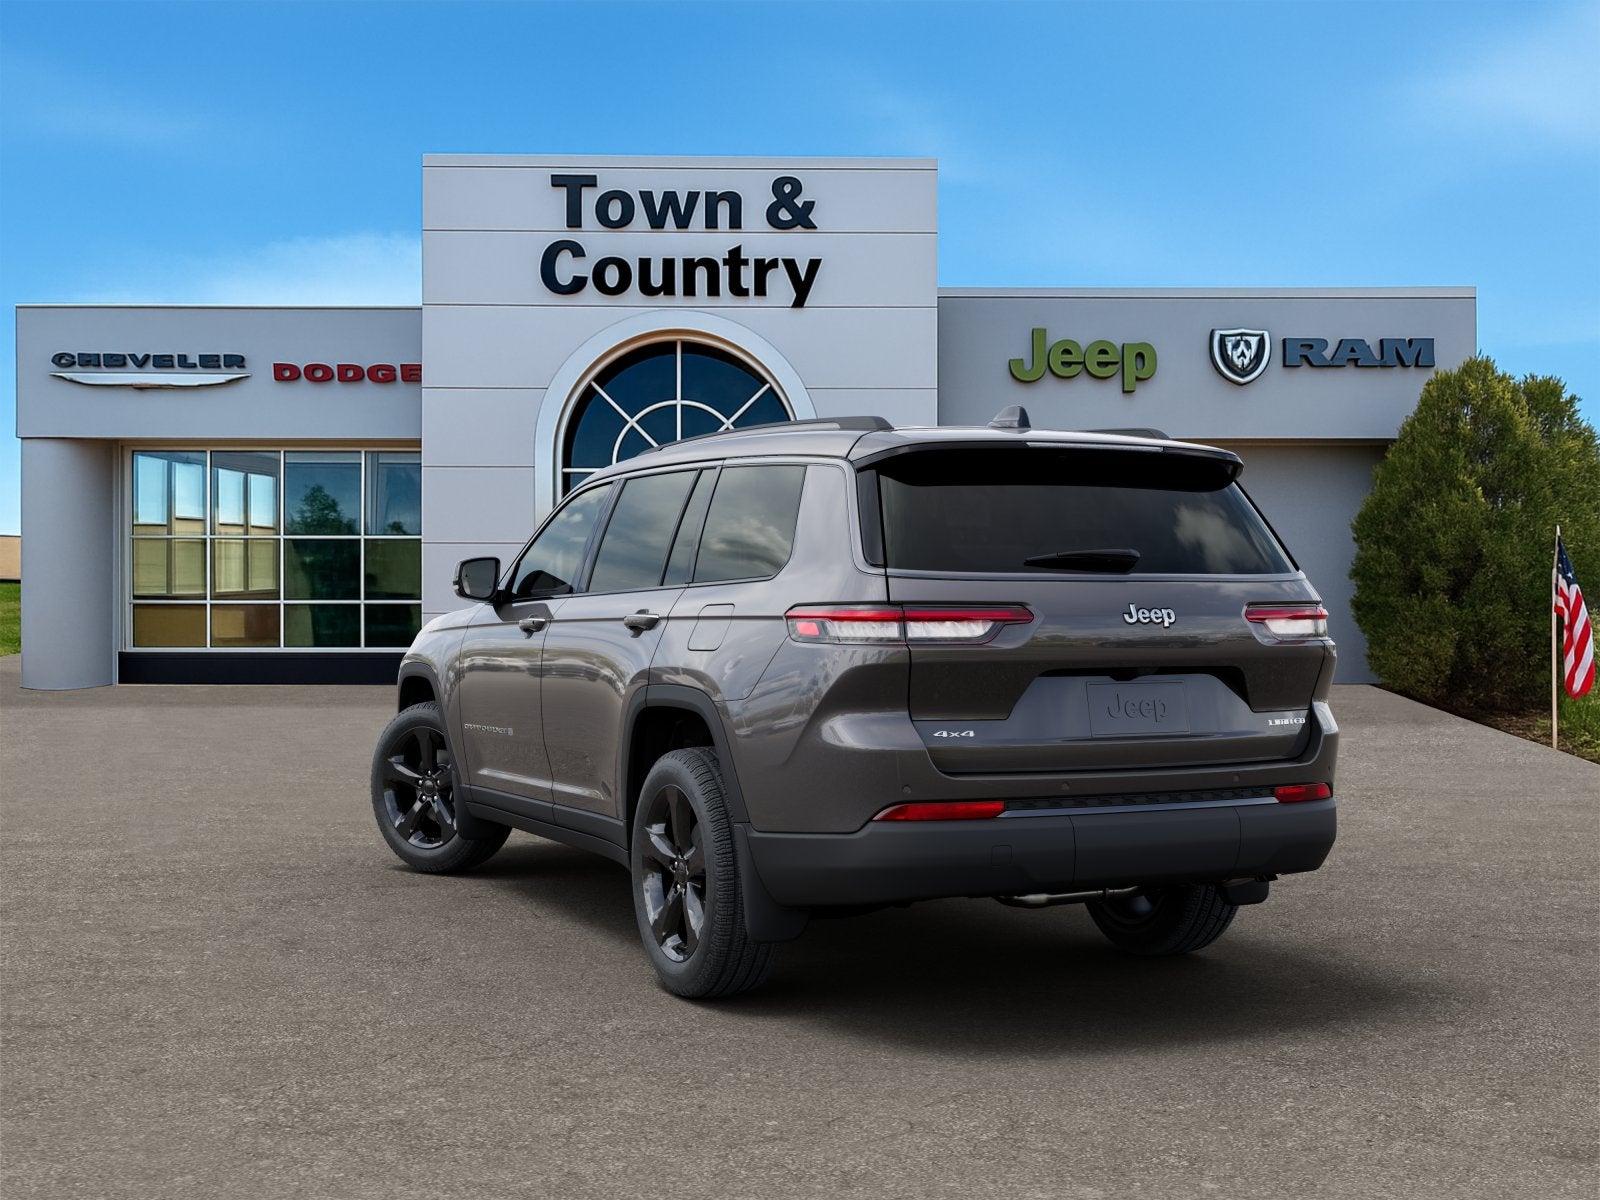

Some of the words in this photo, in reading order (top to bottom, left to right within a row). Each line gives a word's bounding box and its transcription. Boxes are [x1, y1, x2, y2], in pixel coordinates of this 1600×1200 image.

[551, 174, 742, 230] Town
[765, 176, 818, 230] &
[540, 239, 822, 308] Country
[1008, 327, 1158, 393] Jeep
[1282, 337, 1436, 368] RAM
[273, 363, 422, 383] DODGE
[1123, 603, 1176, 628] Jeep
[1107, 692, 1167, 723] Jeep
[932, 730, 975, 738] 4x4
